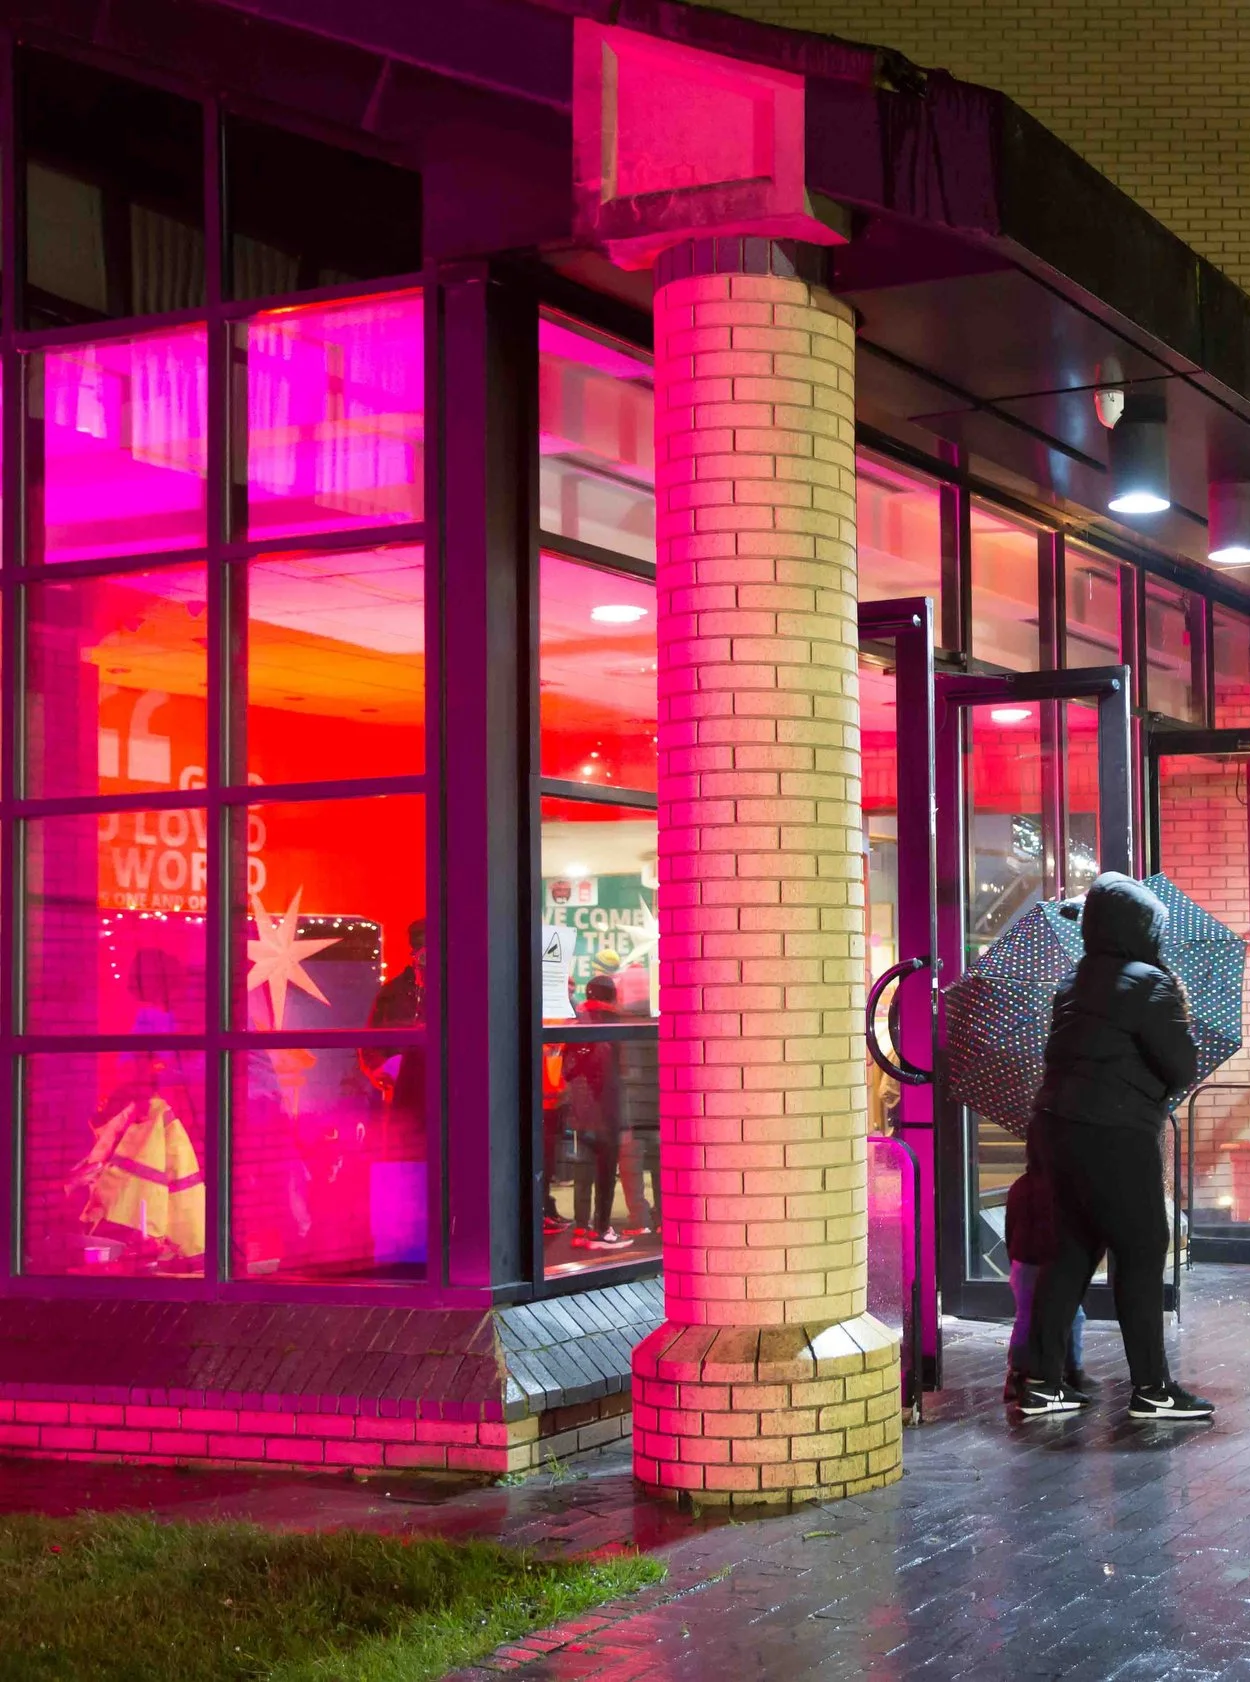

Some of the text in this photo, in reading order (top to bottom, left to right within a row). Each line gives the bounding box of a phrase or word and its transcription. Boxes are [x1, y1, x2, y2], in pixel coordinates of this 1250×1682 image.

[111, 848, 267, 894] WORD
[113, 891, 147, 909] ONE
[151, 892, 185, 910] AND
[573, 907, 645, 931] COME
